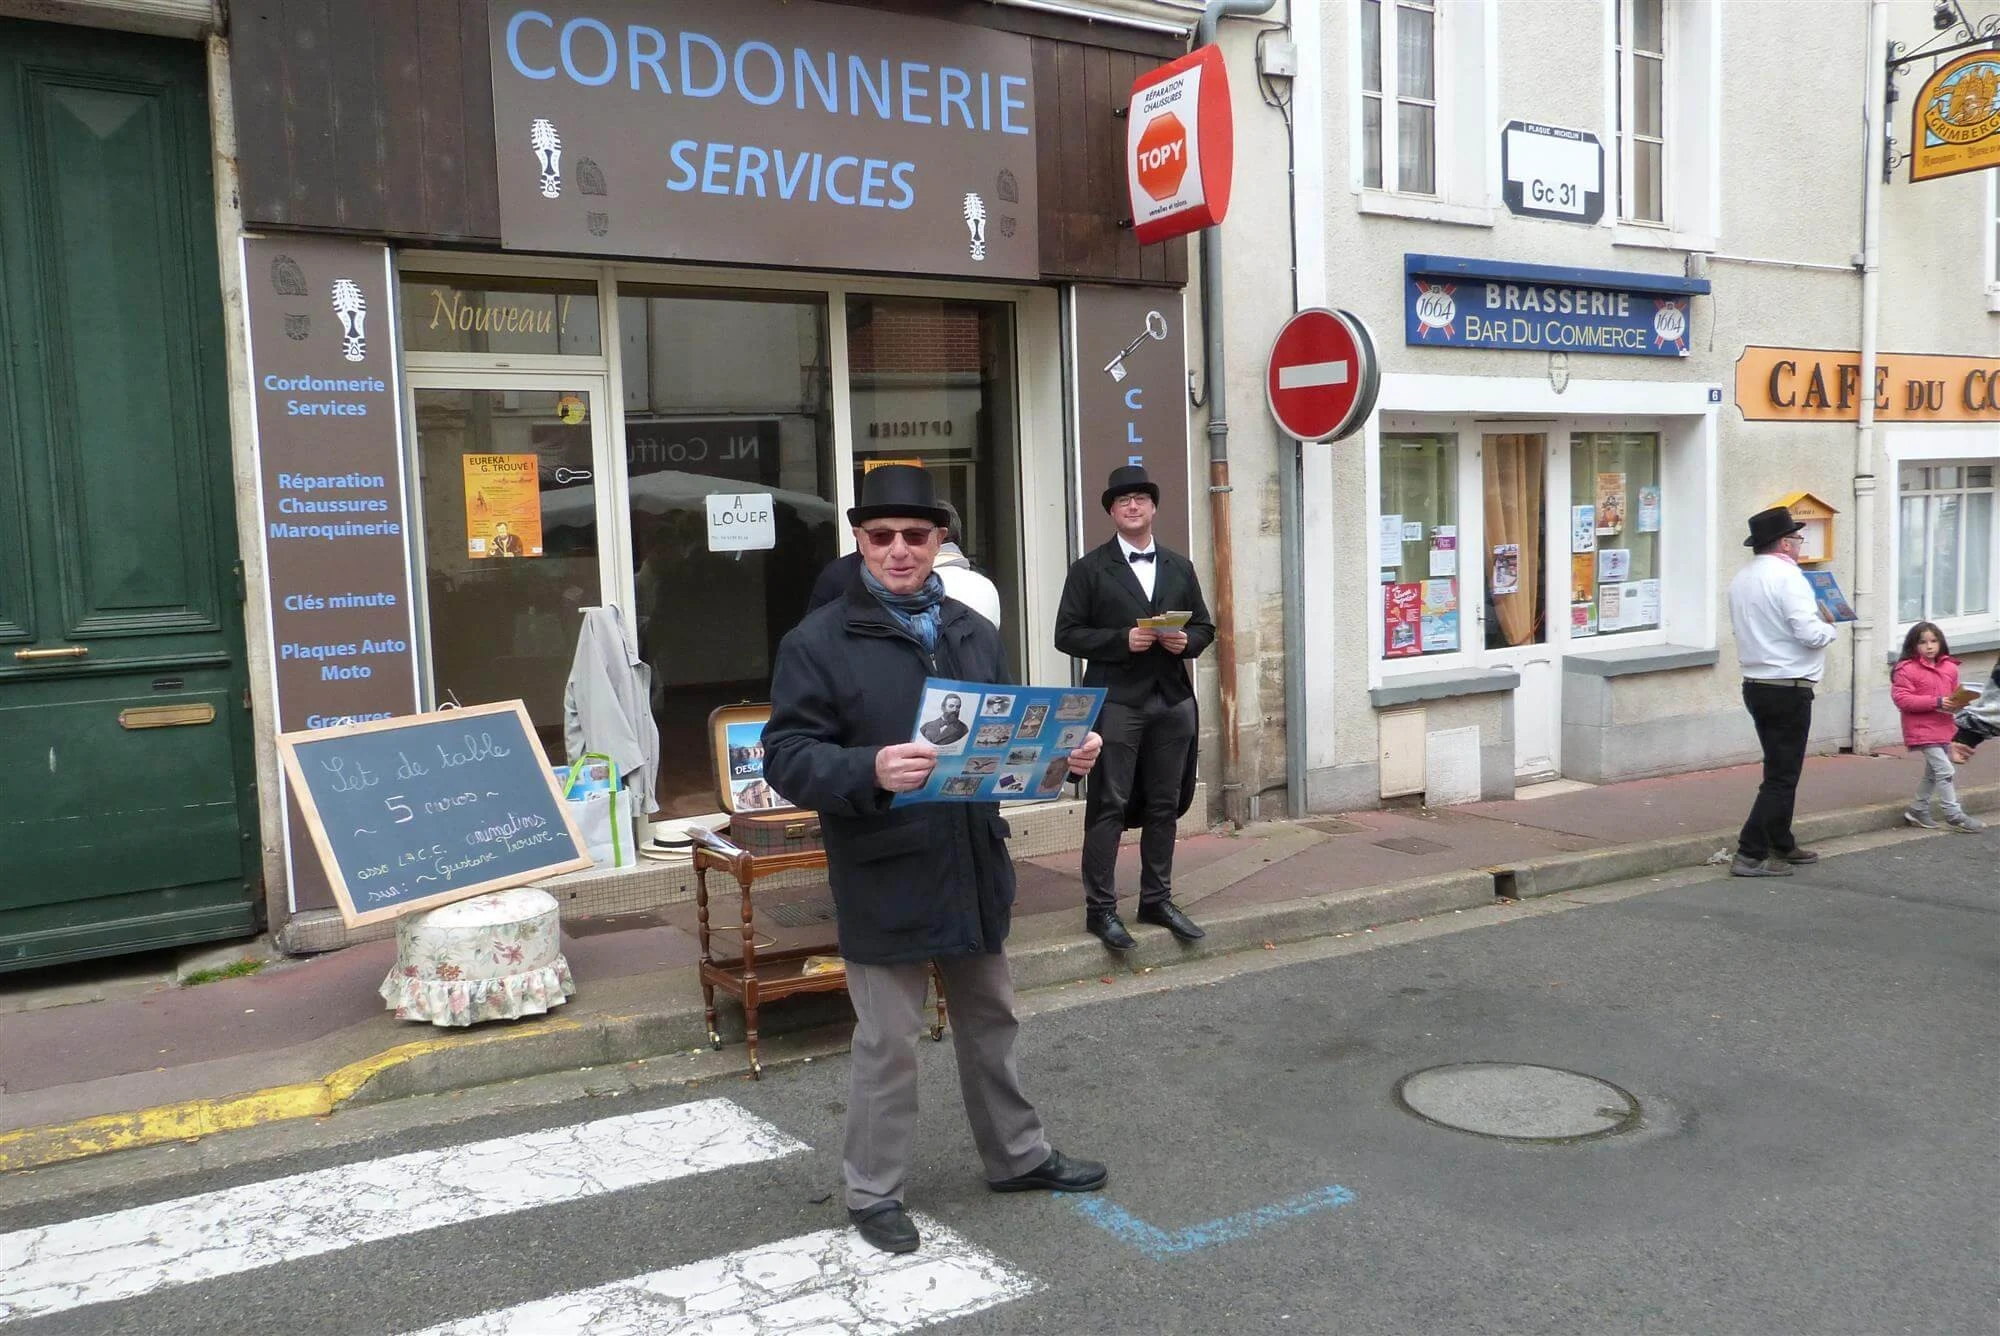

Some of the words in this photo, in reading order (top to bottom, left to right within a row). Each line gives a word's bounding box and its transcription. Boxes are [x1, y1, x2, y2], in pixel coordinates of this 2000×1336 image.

[506, 11, 1029, 135] CORDONNERIE
[1145, 78, 1184, 103] RÉPARATION
[1143, 90, 1182, 114] CHAUSSURES
[1528, 125, 1551, 136] PLAQUE
[1139, 138, 1184, 173] TOPY
[666, 139, 916, 210] SERVICES
[1532, 179, 1555, 203] Gc
[1560, 183, 1577, 207] 31
[1420, 296, 1453, 320] 1664
[1485, 283, 1630, 317] BRASSERIE
[1465, 315, 1508, 343] BAR
[1544, 320, 1647, 349] COMMERCE
[1656, 313, 1685, 331] 1664
[263, 375, 385, 392] Cordonnerie
[1769, 360, 1890, 410] CAFE
[1905, 380, 1946, 411] DU
[1712, 390, 1719, 401] 6
[287, 400, 367, 416] Services
[469, 456, 505, 465] EUREKA
[278, 473, 385, 493] Réparation
[279, 498, 388, 514] Chaussures
[733, 495, 743, 509] A
[713, 511, 768, 526] LOUER
[270, 520, 401, 540] Maroquinerie
[284, 594, 325, 611] Clés
[329, 592, 396, 609] minute
[280, 641, 357, 661] Plaques
[361, 639, 406, 655] Auto
[321, 664, 371, 680] Moto
[397, 752, 430, 781] de
[440, 732, 511, 768] table
[384, 795, 414, 824] 5
